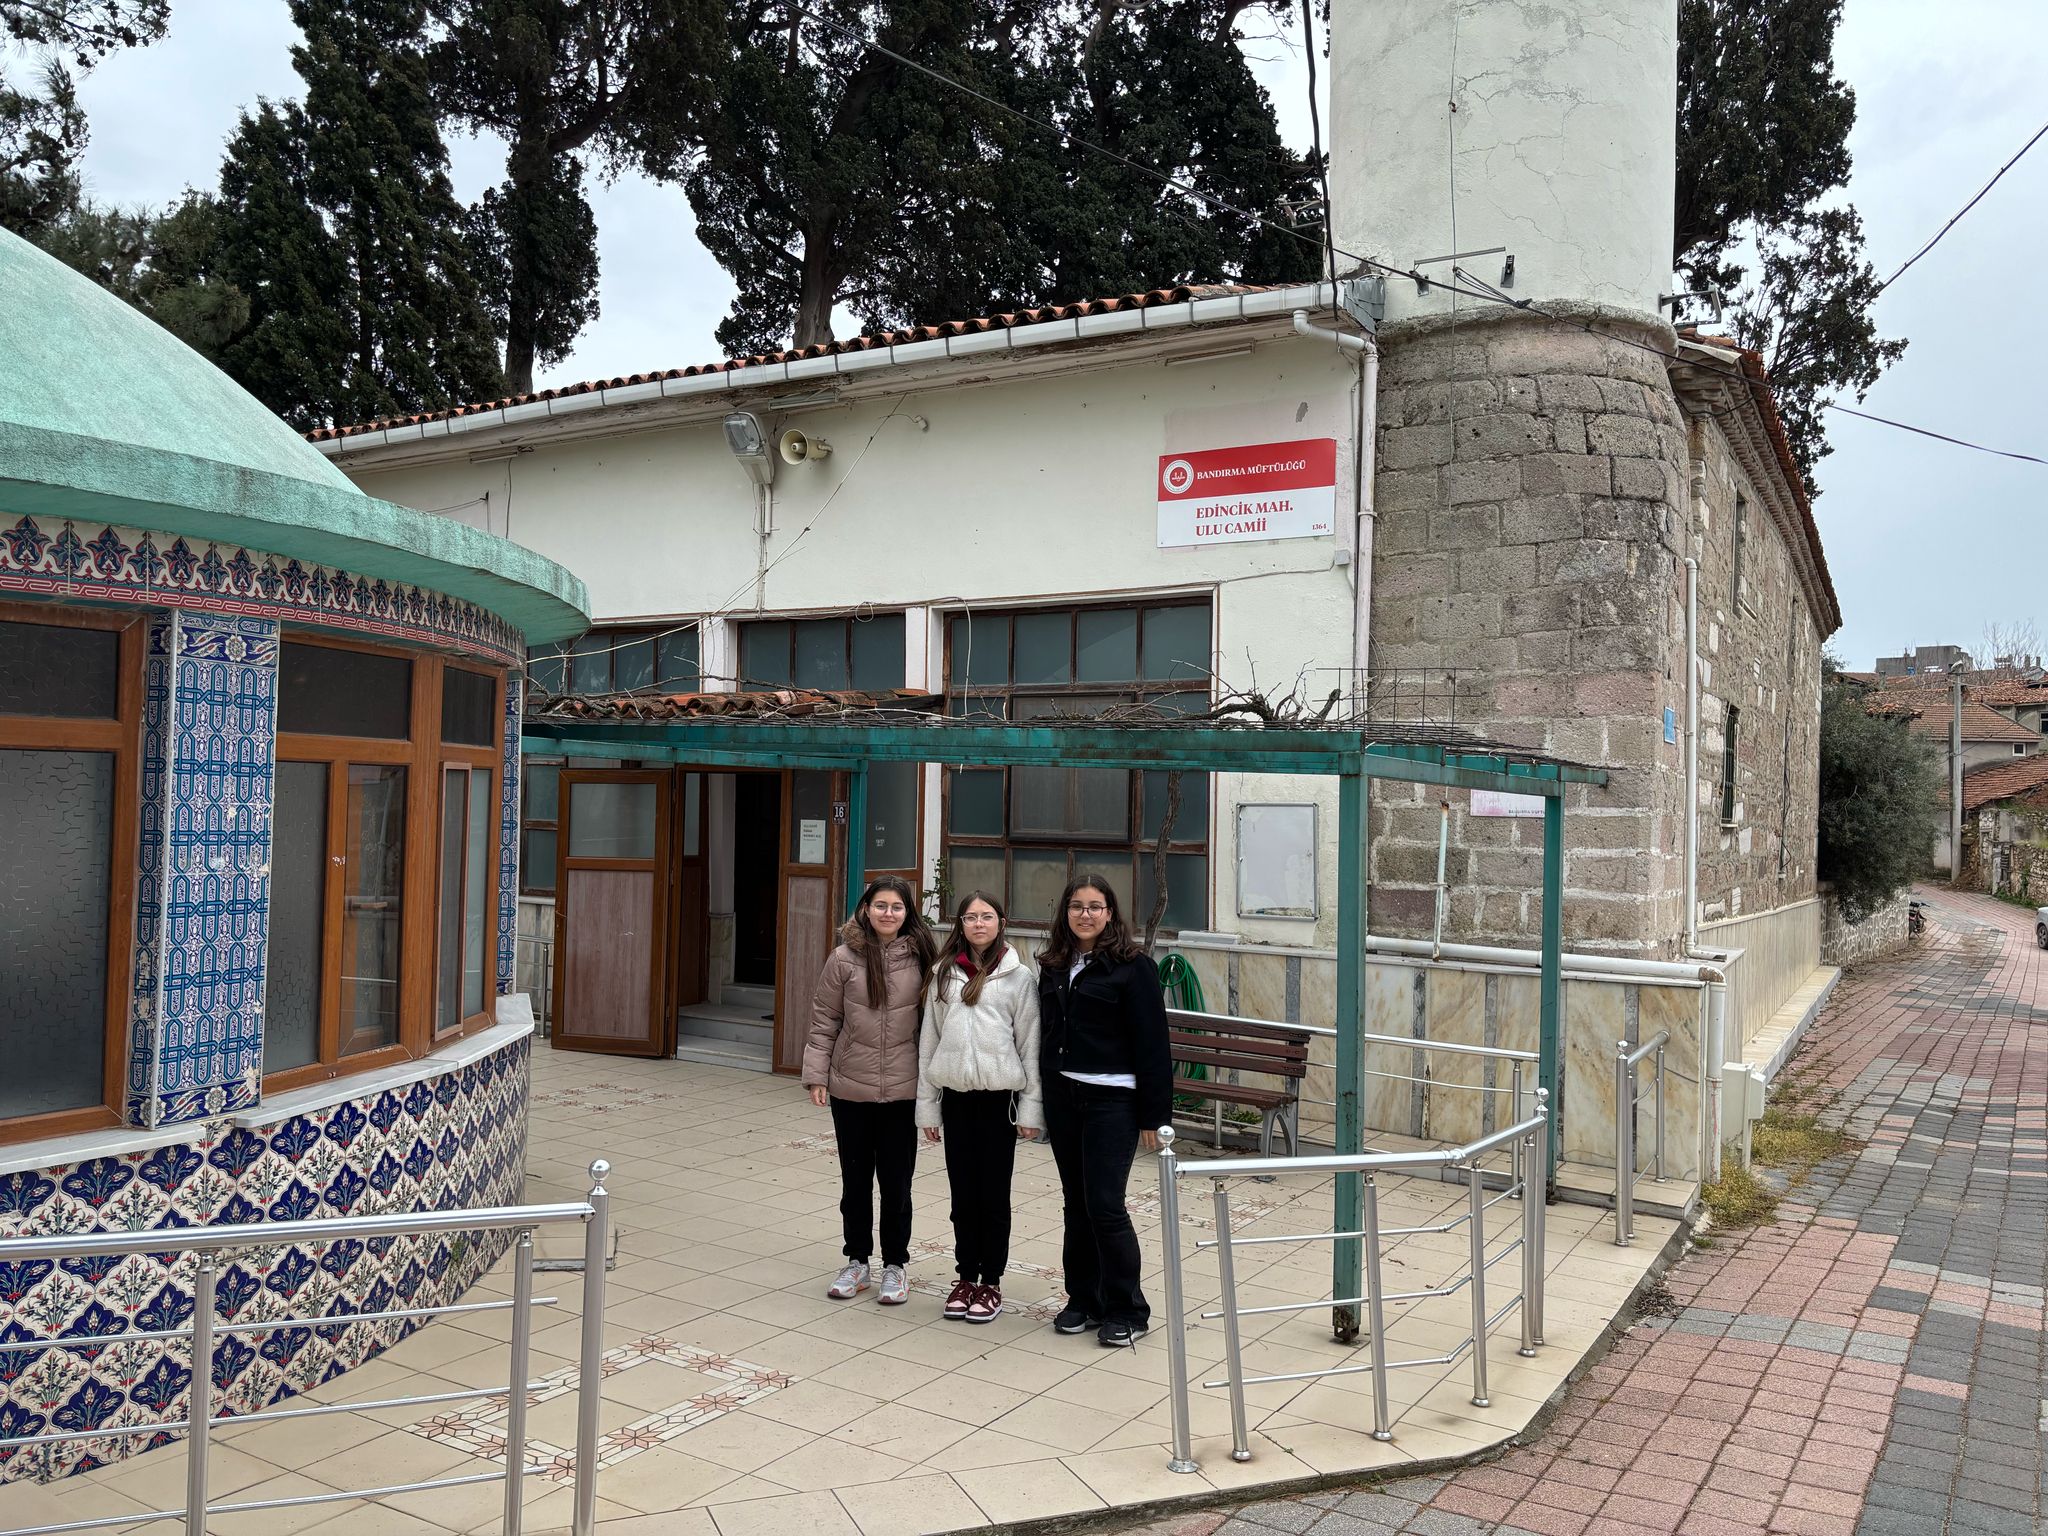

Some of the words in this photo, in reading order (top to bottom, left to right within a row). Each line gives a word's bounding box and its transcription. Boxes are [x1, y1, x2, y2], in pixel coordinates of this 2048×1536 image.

[1197, 467, 1246, 480] BANDIRMA
[1248, 460, 1306, 474] MÜFTÜLÜĞÜ
[1196, 502, 1253, 519] EDİNCİK
[1256, 500, 1294, 514] MAH.
[1195, 524, 1223, 537] ULU
[1224, 518, 1267, 534] CAMİİ
[834, 806, 844, 818] 16
